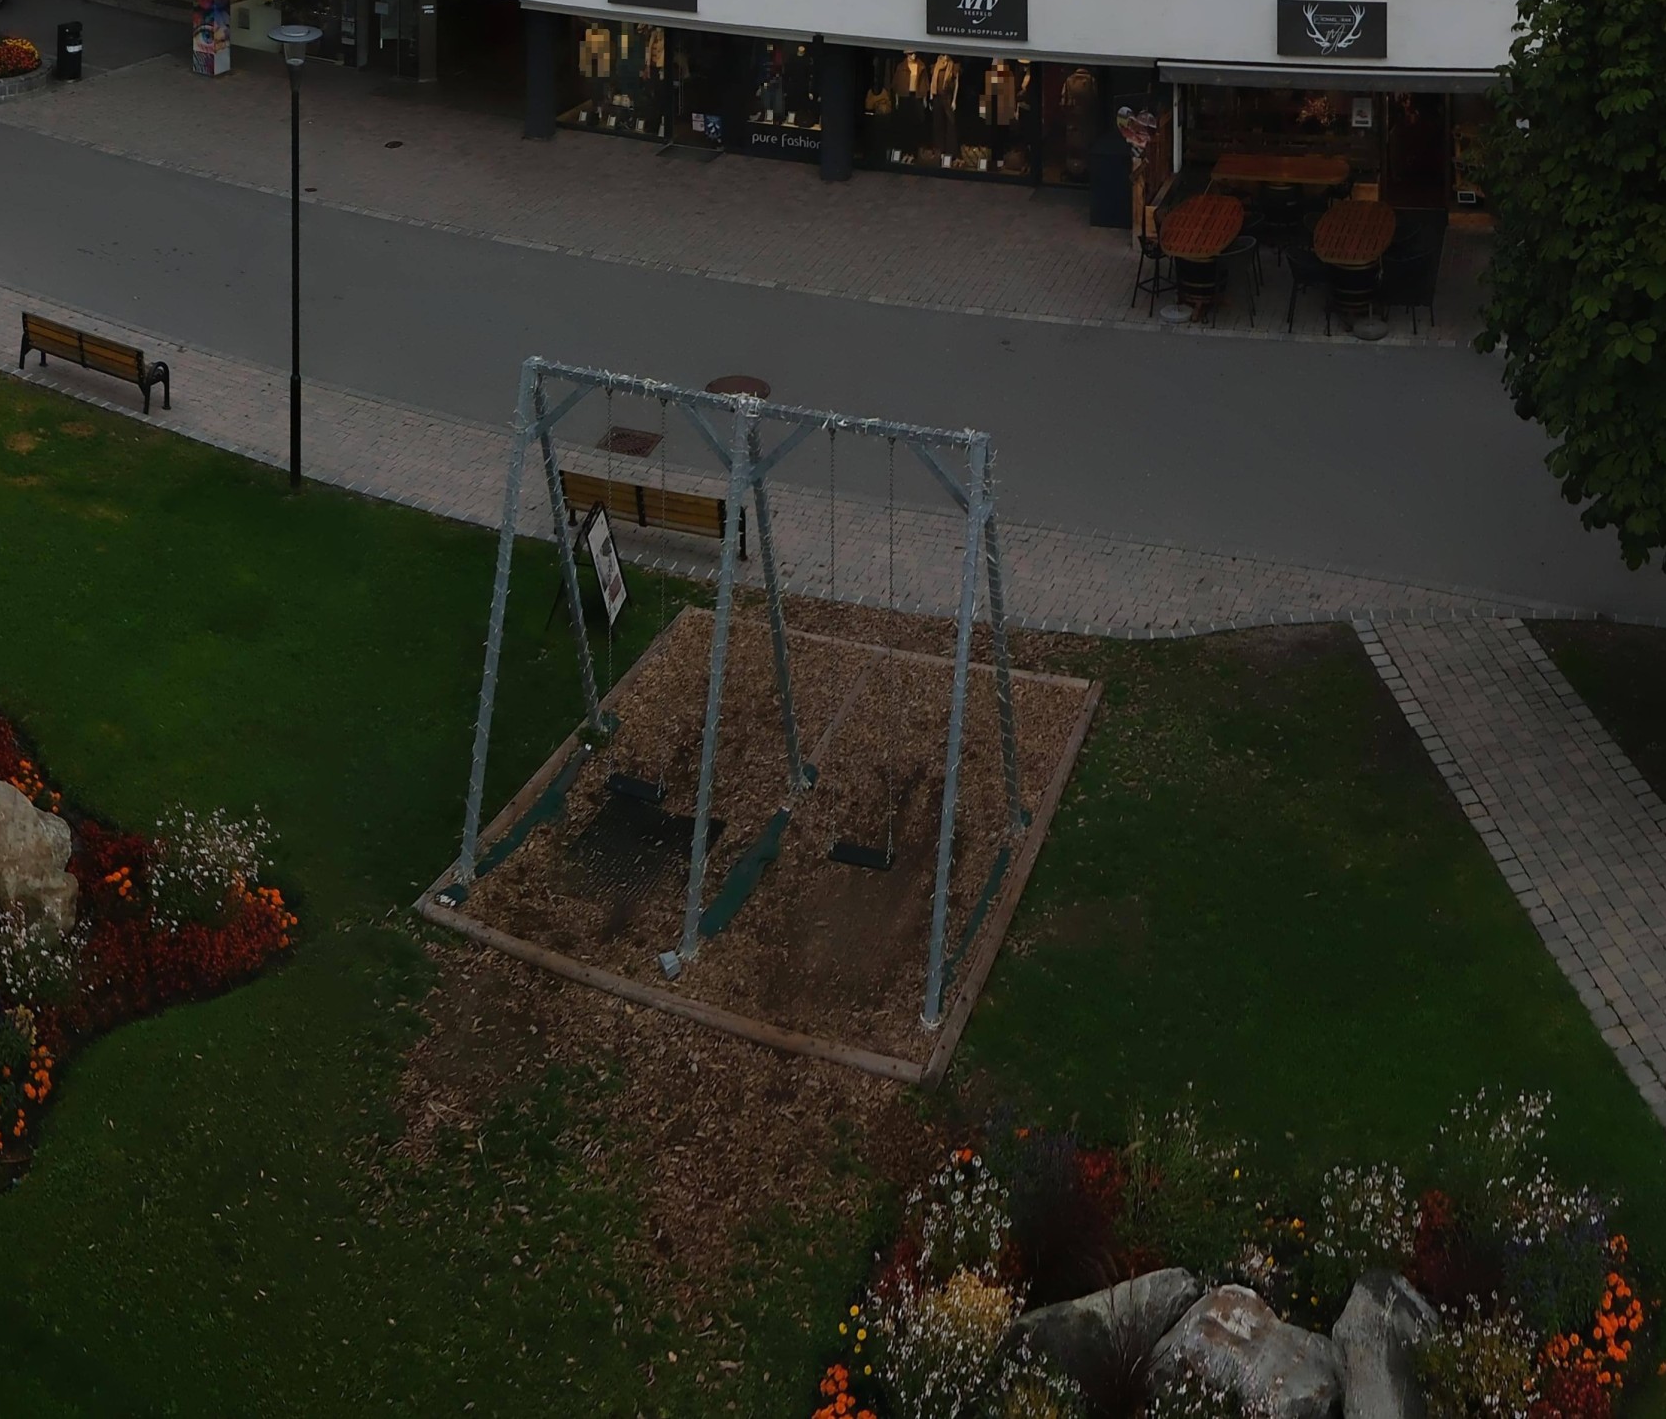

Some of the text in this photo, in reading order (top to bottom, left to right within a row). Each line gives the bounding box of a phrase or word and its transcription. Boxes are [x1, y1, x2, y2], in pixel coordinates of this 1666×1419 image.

[936, 26, 966, 34] SEEFELD
[967, 28, 1003, 36] SHOPPING
[751, 133, 777, 144] pure
